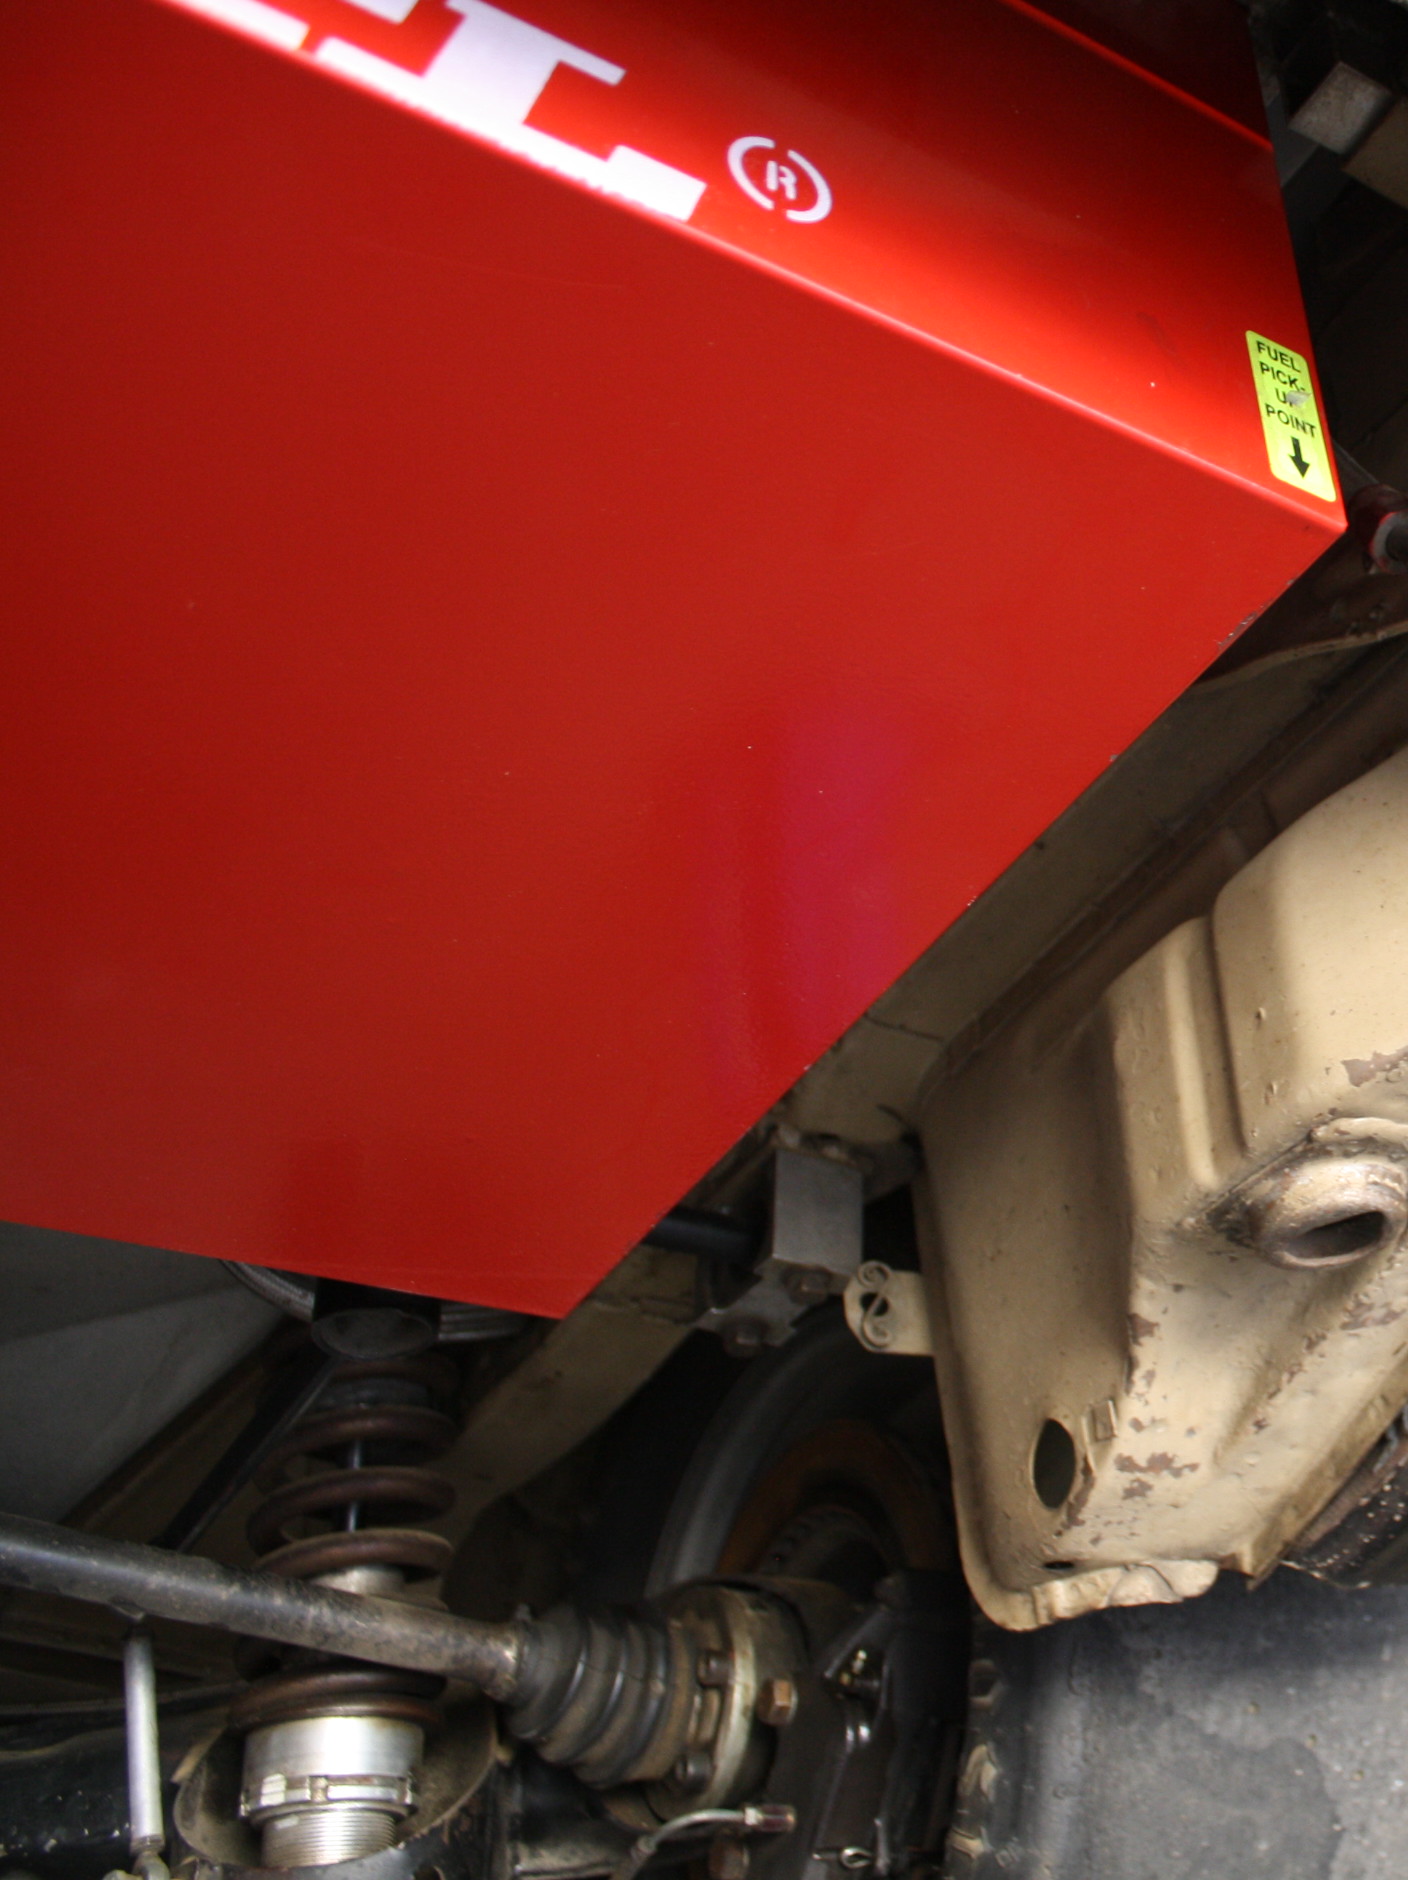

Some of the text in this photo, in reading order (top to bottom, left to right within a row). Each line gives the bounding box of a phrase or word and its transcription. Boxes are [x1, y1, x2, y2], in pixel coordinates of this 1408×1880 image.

[1256, 340, 1302, 373] FUEL
[1259, 361, 1306, 392] PICK-
[1265, 403, 1317, 438] POINT
